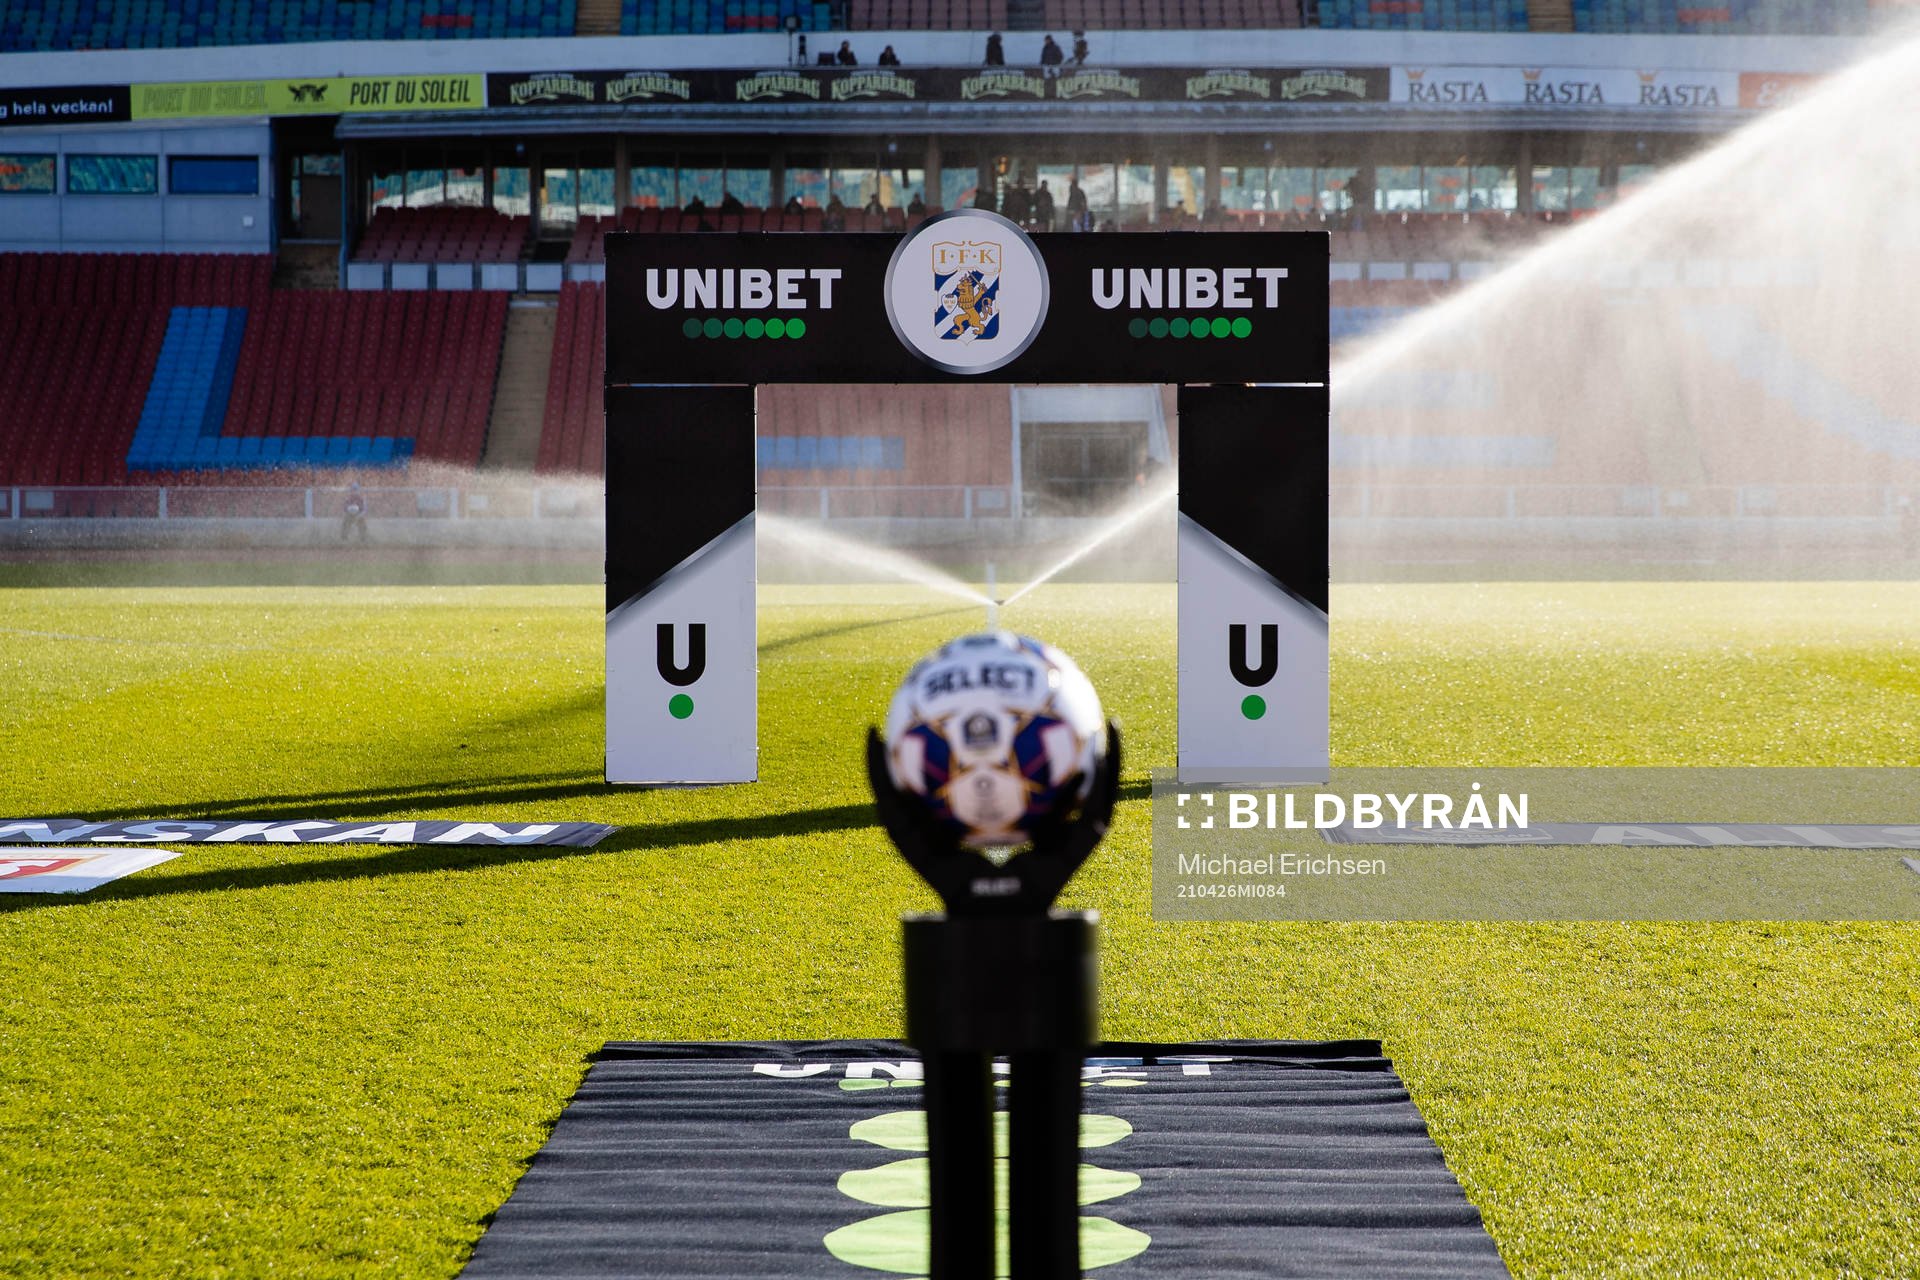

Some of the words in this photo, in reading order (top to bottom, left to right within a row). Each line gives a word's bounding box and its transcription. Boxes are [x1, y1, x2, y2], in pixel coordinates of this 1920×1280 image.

[13, 100, 47, 115] hela
[51, 98, 113, 114] veckan!
[351, 81, 391, 105] PORT
[395, 80, 416, 104] DU
[420, 79, 471, 103] SOLEIL
[1408, 81, 1488, 103] RASTA
[1524, 82, 1605, 104] RASTA
[1639, 84, 1720, 107] RASTA
[646, 268, 842, 309] UNIBET
[1091, 268, 1289, 309] UNIBET
[657, 623, 706, 687] U
[1229, 623, 1279, 688] U
[924, 661, 1036, 699] SELECT
